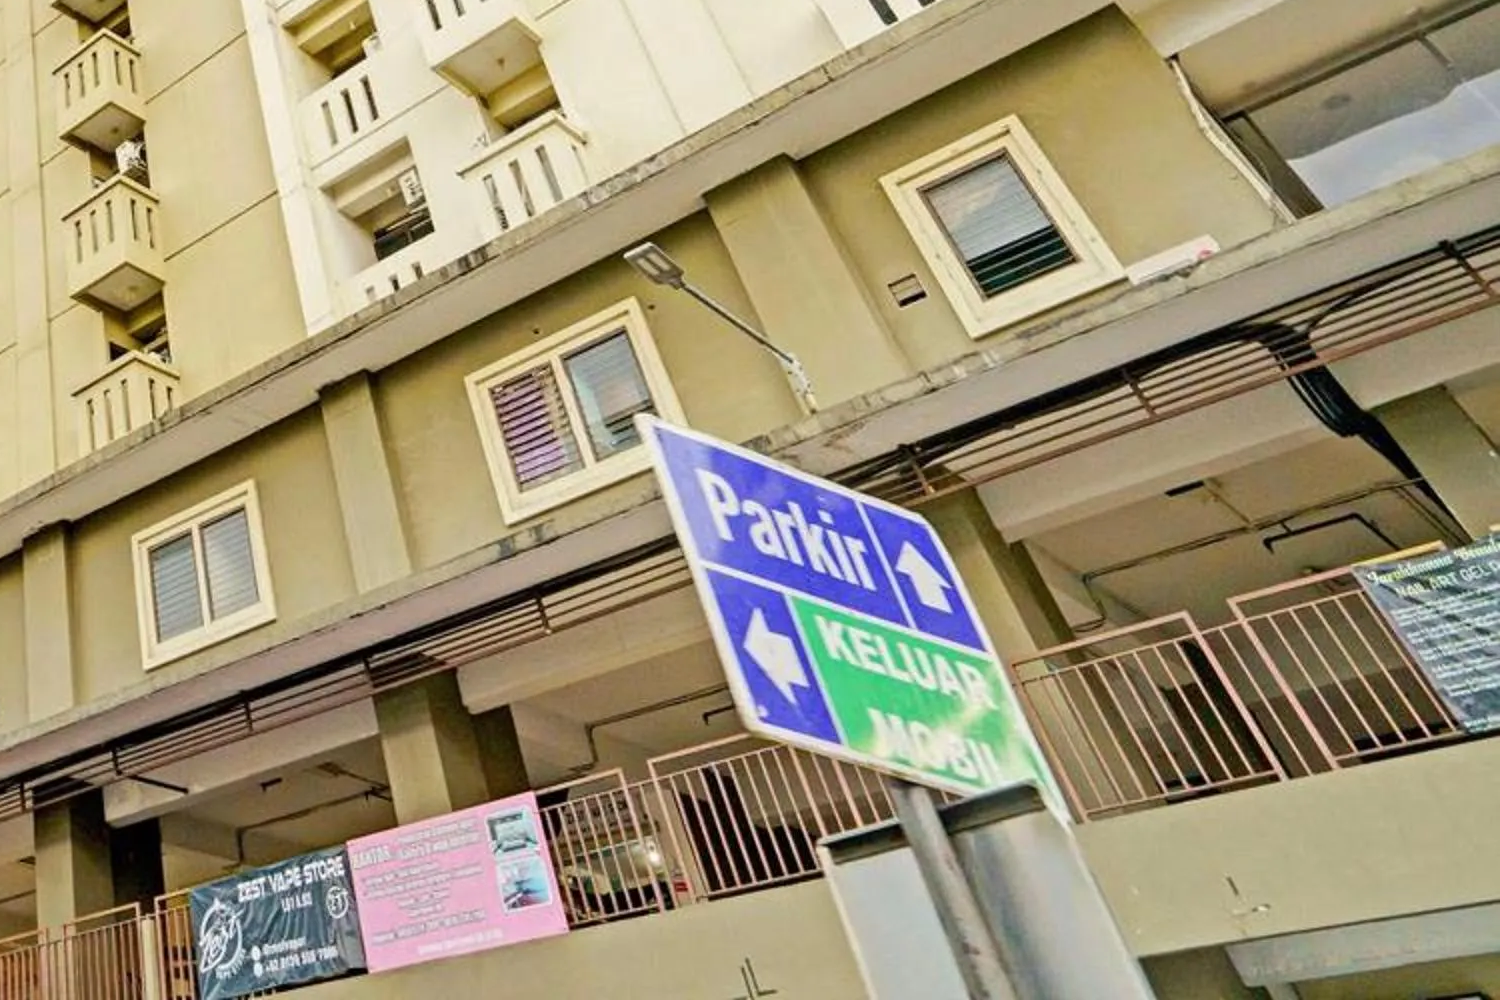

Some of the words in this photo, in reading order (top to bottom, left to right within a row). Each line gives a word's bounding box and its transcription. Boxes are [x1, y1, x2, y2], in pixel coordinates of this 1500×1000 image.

[695, 468, 878, 592] Parkir
[813, 616, 1000, 709] KELUAR
[237, 877, 267, 903] ZEST
[268, 866, 303, 892] VAPE
[303, 855, 345, 884] STORE
